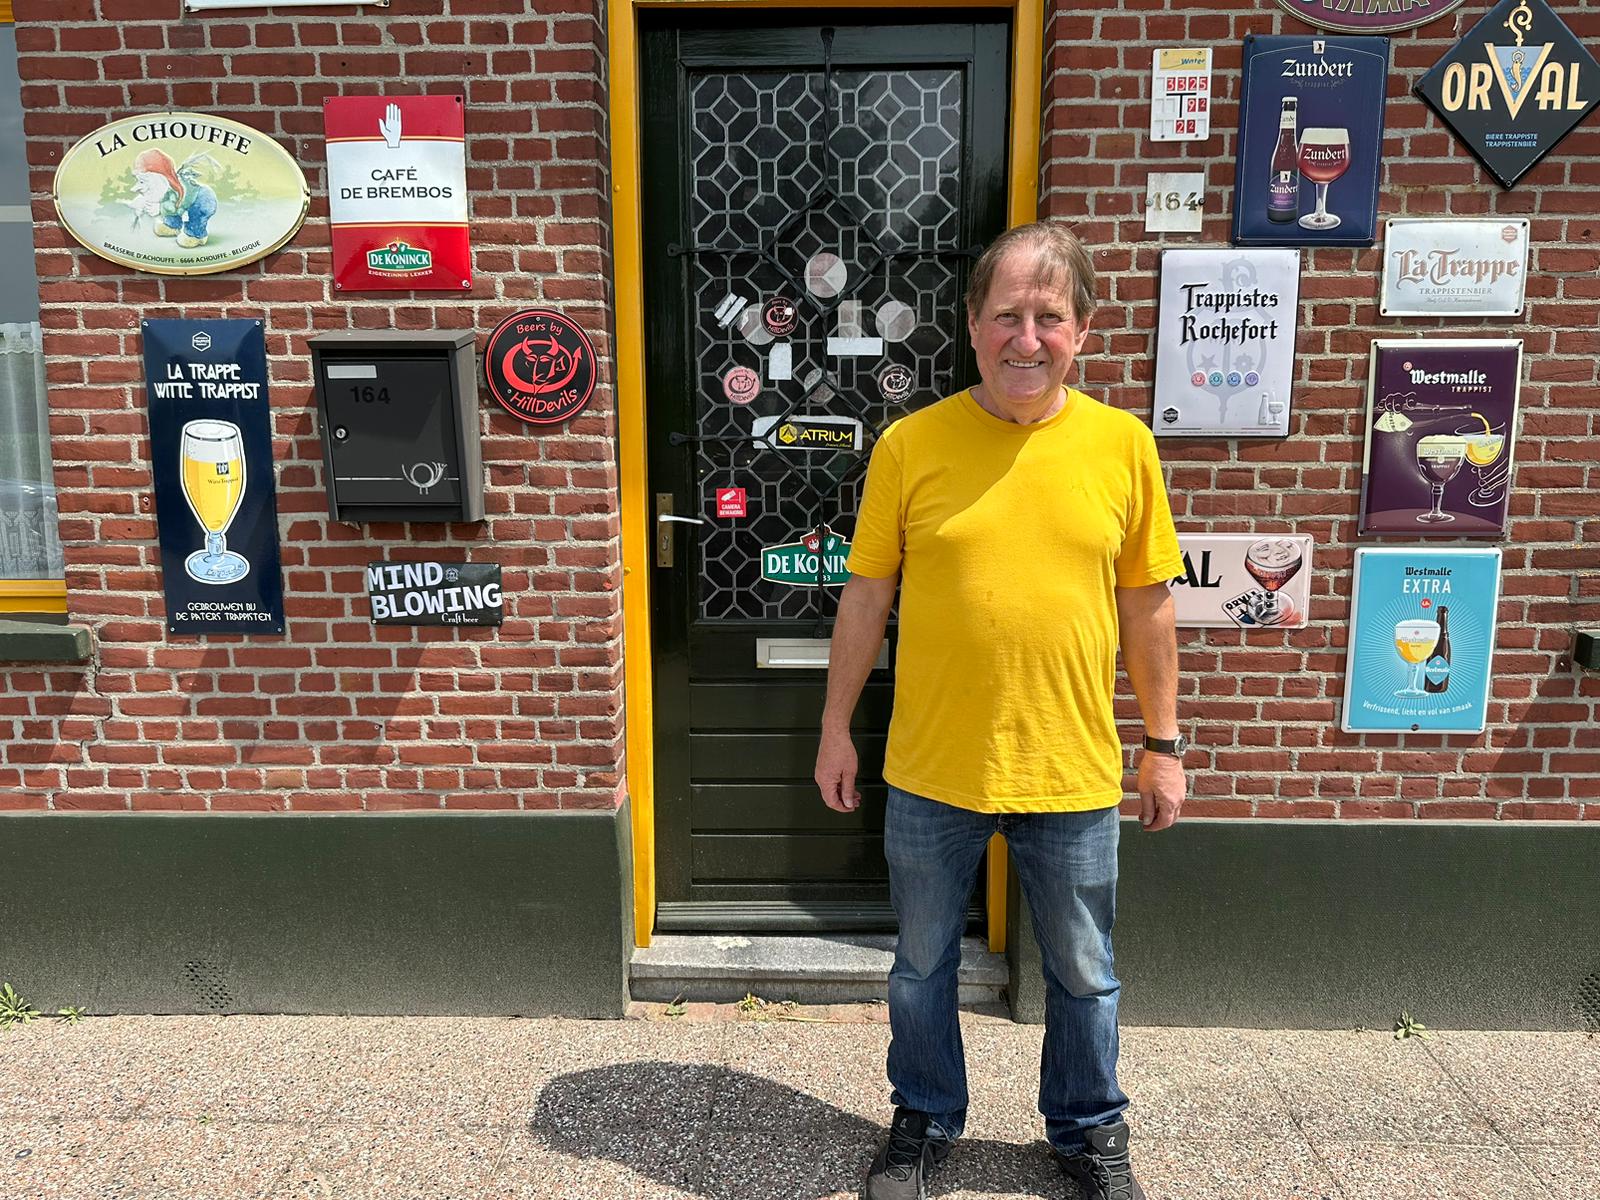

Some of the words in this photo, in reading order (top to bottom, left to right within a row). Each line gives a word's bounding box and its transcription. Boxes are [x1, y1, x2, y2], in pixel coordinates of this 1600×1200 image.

[1281, 56, 1354, 77] Zundert
[1442, 42, 1588, 121] ORVAL
[94, 136, 128, 158] LA
[132, 122, 252, 156] CHOUFFE
[1304, 147, 1346, 160] Zundert
[371, 166, 418, 182] CAFÉ
[340, 187, 362, 200] DE
[367, 186, 452, 199] BREMBOS
[1152, 191, 1199, 212] 164
[104, 242, 135, 258] BRASSERIE
[196, 252, 228, 264] ACHOUFFE
[232, 240, 261, 256] BELGIQUE
[384, 254, 429, 265] KONINCK
[1392, 249, 1429, 290] La
[1428, 248, 1520, 286] Trappe
[1180, 283, 1279, 314] Trappistes
[1418, 287, 1492, 295] TRAPPISTENBIER
[516, 322, 546, 334] Beers
[550, 322, 563, 336] by
[1179, 315, 1279, 346] Rochefort
[167, 363, 184, 380] LA
[188, 363, 241, 380] TRAPPE
[1410, 370, 1487, 384] Westmalle
[154, 382, 194, 399] WITTE
[198, 382, 260, 400] TRAPPIST
[350, 386, 391, 404] 164
[509, 390, 578, 414] HillDevils
[800, 428, 853, 443] ATRIUM
[768, 554, 790, 574] DE
[794, 553, 847, 574] KONIN
[1170, 550, 1222, 588] AL
[1405, 566, 1452, 576] Westmalle
[367, 562, 444, 592] MIND
[814, 574, 831, 582] 133
[1403, 578, 1451, 594] EXTRA
[188, 602, 244, 611] GEBROUWEN
[370, 582, 503, 620] BLOWING
[176, 612, 188, 621] DE
[191, 612, 221, 621] PATERS
[224, 612, 272, 622] TRAPPISTEN
[441, 612, 462, 623] Craft
[462, 613, 479, 623] beer
[1402, 708, 1416, 716] licht
[1428, 708, 1438, 716] vol
[1452, 701, 1473, 712] smaak
